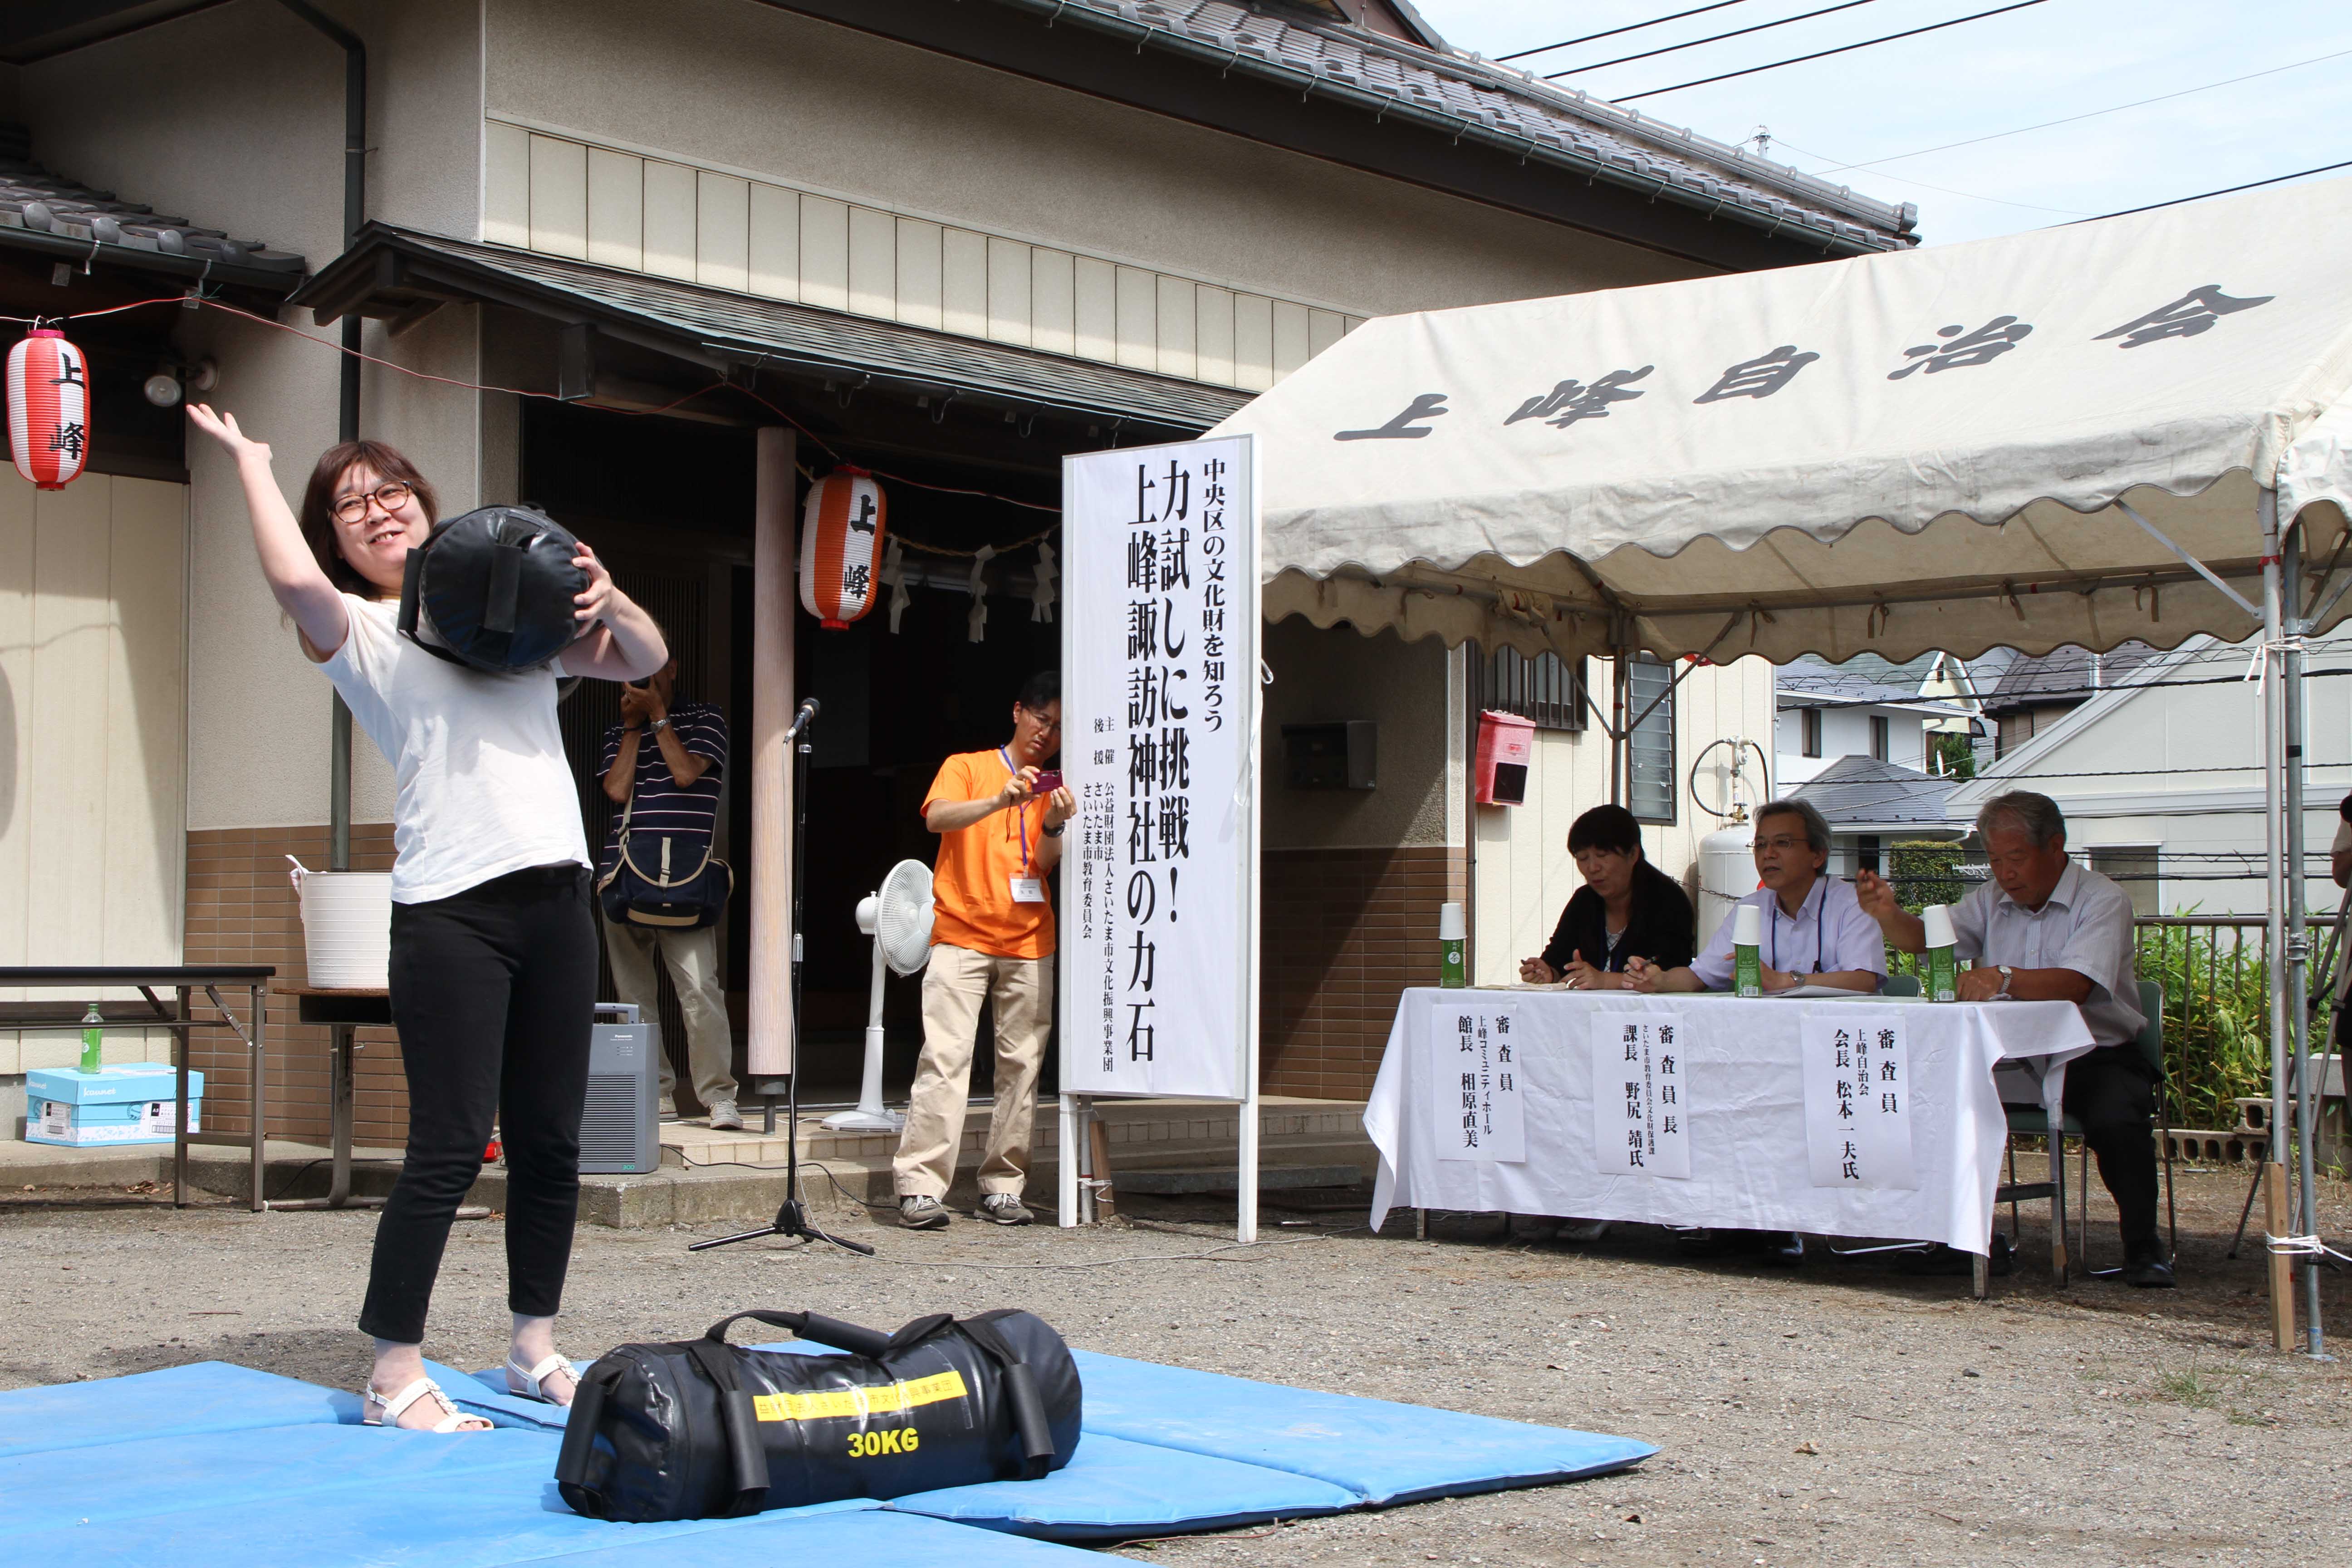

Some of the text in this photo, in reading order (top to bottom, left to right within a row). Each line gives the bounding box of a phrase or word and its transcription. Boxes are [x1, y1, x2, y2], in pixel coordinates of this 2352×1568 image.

[49, 353, 87, 460] 上峰
[1333, 285, 2276, 441] 上峰自治会
[844, 494, 876, 599] 上峰
[1203, 458, 1226, 733] 中央区の文化財を知ろう
[1159, 460, 1190, 923] 力試しに挑戦！
[1127, 464, 1158, 1062] 上峰諏訪神社の力石
[1082, 783, 1093, 939] さいたま市教育委員会
[1094, 782, 1103, 861] さいたま市
[1102, 782, 1114, 1073] 公益財団法人さいたま市文化振興事業団
[1478, 1015, 1492, 1135] 上峰コミュニティホール
[1495, 1015, 1513, 1092] 審査員
[1643, 1024, 1655, 1155] さいたま市教育委員会文化財保護課
[1658, 1024, 1677, 1134] 審査員長
[1856, 1029, 1869, 1096] 上峰自治会
[1877, 1029, 1897, 1113] 審査員
[847, 1427, 919, 1458] 30KG
